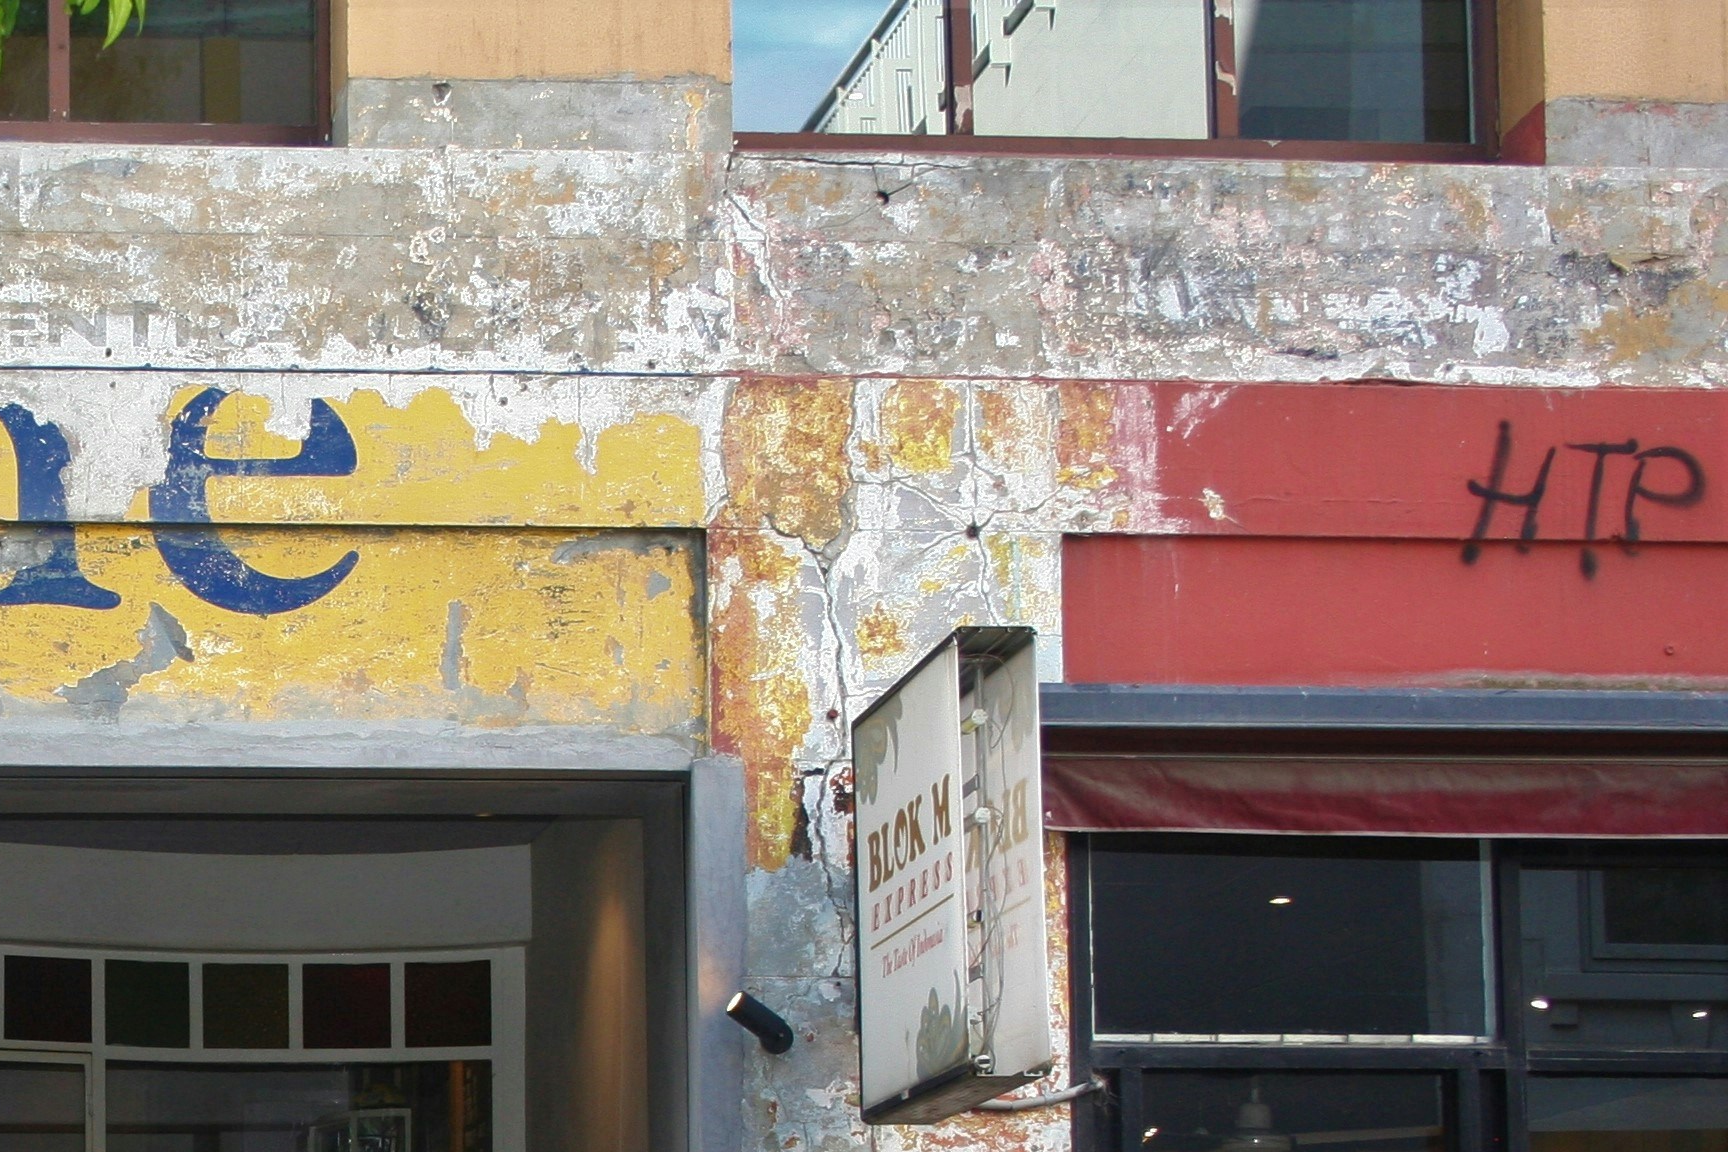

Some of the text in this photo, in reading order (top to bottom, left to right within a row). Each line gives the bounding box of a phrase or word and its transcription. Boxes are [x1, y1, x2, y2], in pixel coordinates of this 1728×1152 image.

[867, 793, 927, 893] BLOK
[931, 773, 953, 846] M
[872, 851, 953, 933] EXPRESS
[882, 953, 893, 978] The
